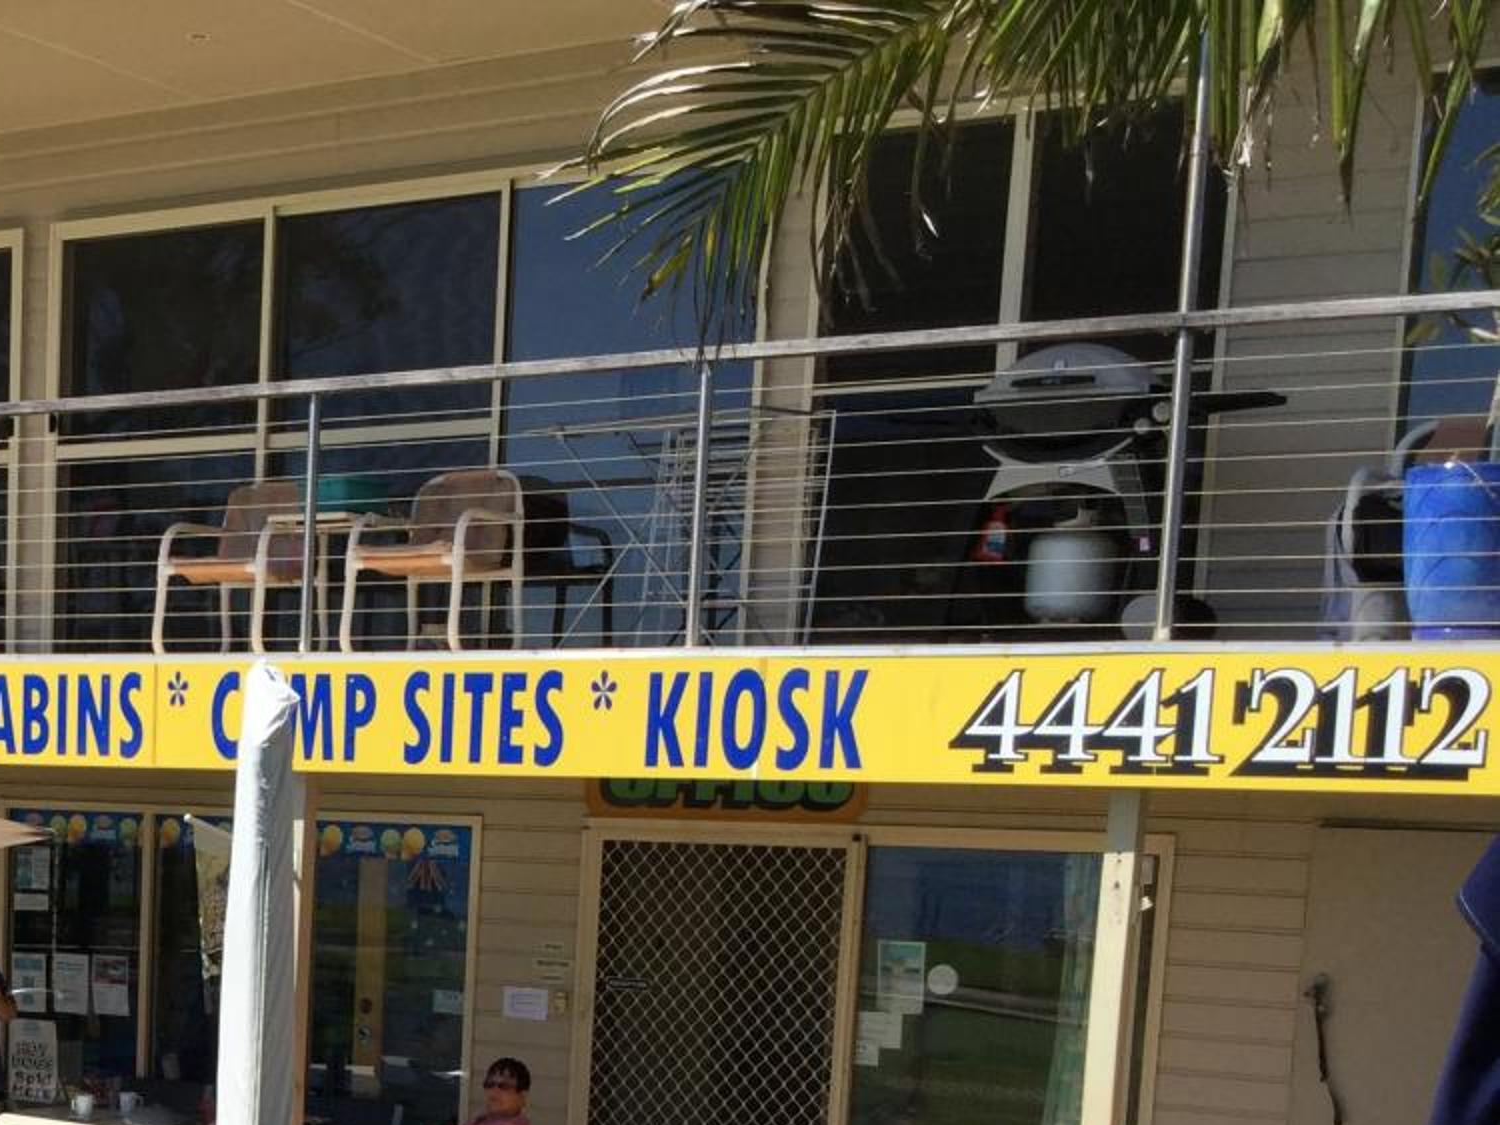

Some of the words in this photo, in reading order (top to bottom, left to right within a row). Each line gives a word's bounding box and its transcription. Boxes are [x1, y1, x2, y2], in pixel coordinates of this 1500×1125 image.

[211, 671, 376, 762] CMP
[403, 670, 564, 766] SITES
[644, 668, 869, 771] KIOSK
